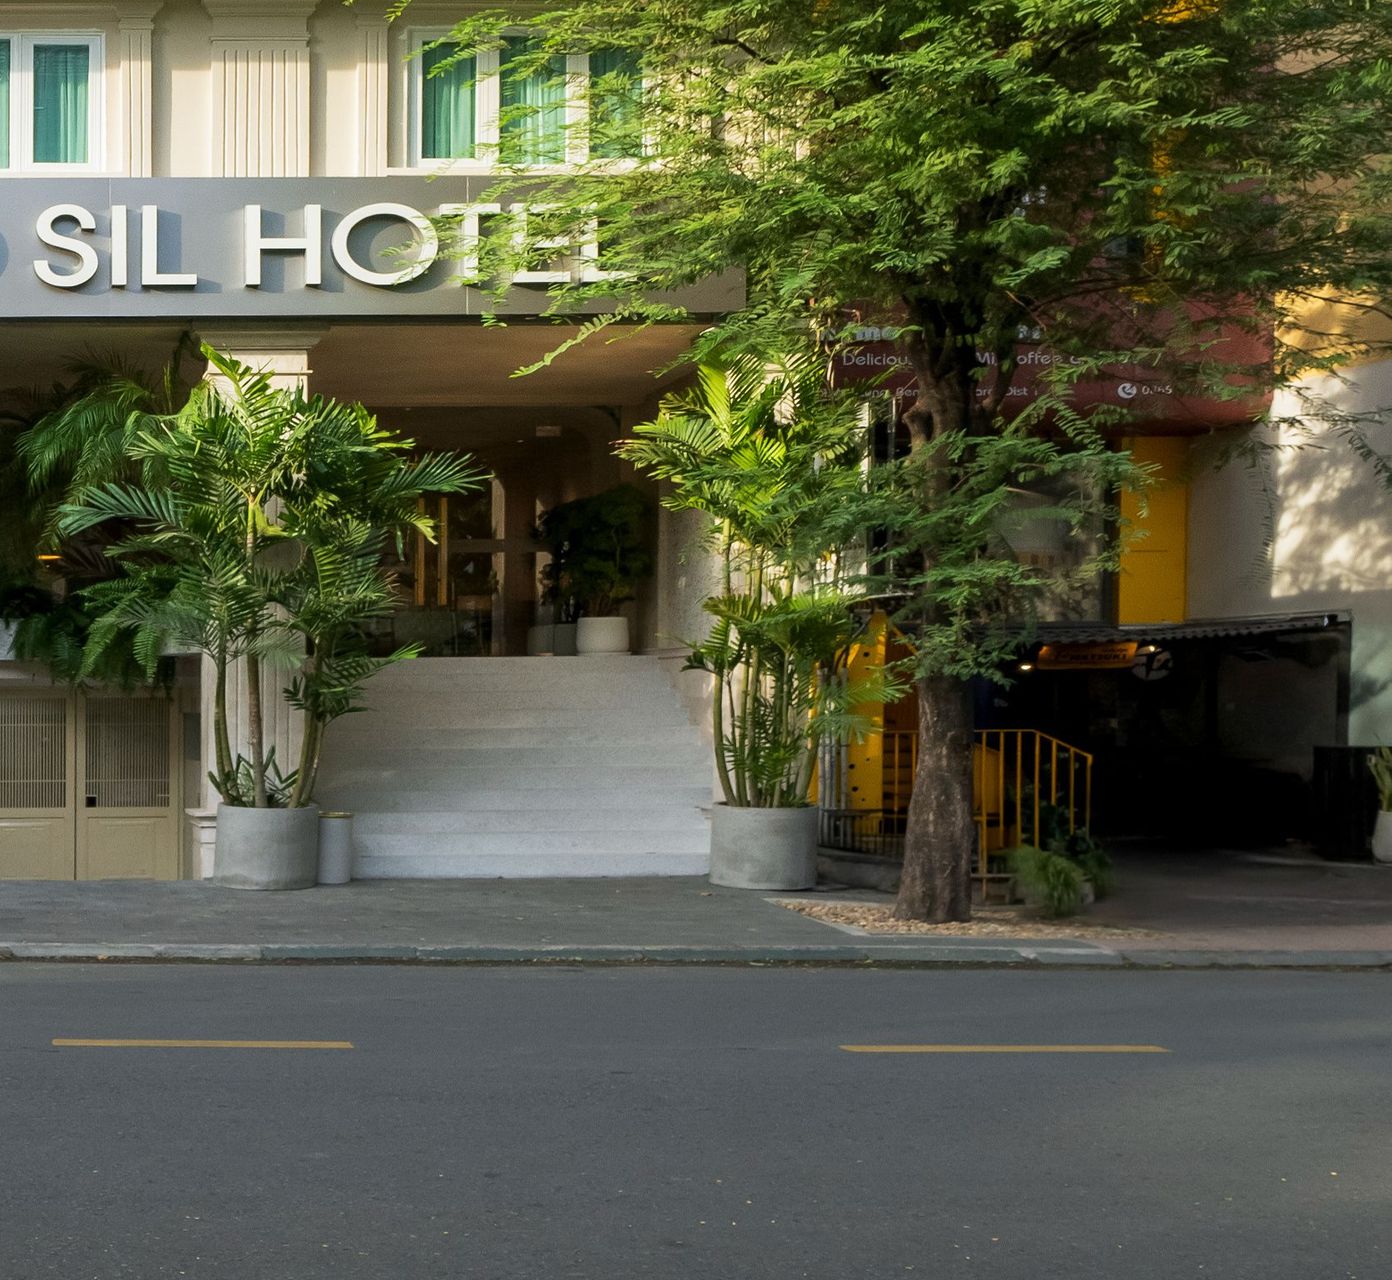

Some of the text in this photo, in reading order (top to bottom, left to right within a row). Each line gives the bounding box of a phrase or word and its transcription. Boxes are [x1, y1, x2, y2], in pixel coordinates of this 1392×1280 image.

[33, 203, 199, 288] SIL
[243, 201, 639, 287] HOTEL
[843, 352, 912, 367] Deliciou
